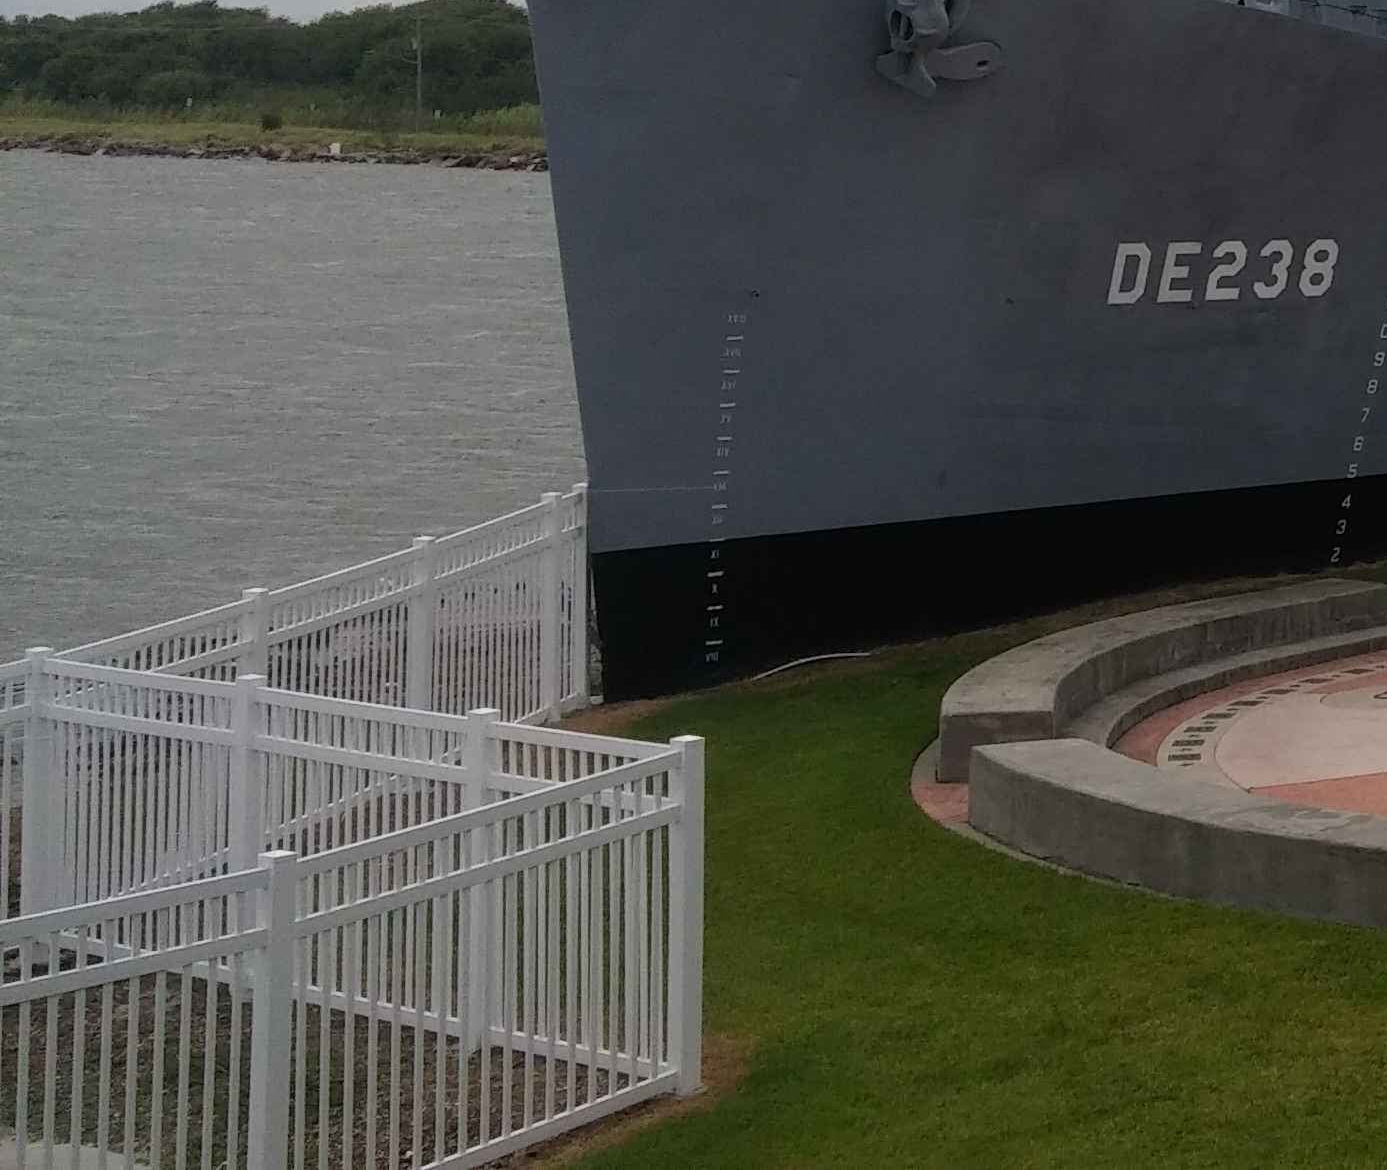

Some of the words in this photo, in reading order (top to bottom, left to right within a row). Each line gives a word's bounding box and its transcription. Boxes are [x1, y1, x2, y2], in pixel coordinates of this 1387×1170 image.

[1107, 238, 1339, 305] DE238
[1373, 351, 1385, 366] 9
[1366, 379, 1378, 394] 8
[1361, 407, 1371, 422] 7
[1353, 436, 1365, 451] 6
[1347, 463, 1358, 478] 5
[1341, 494, 1352, 509] 4
[1336, 519, 1347, 535] 3
[1330, 547, 1341, 563] 2
[711, 583, 718, 594] X
